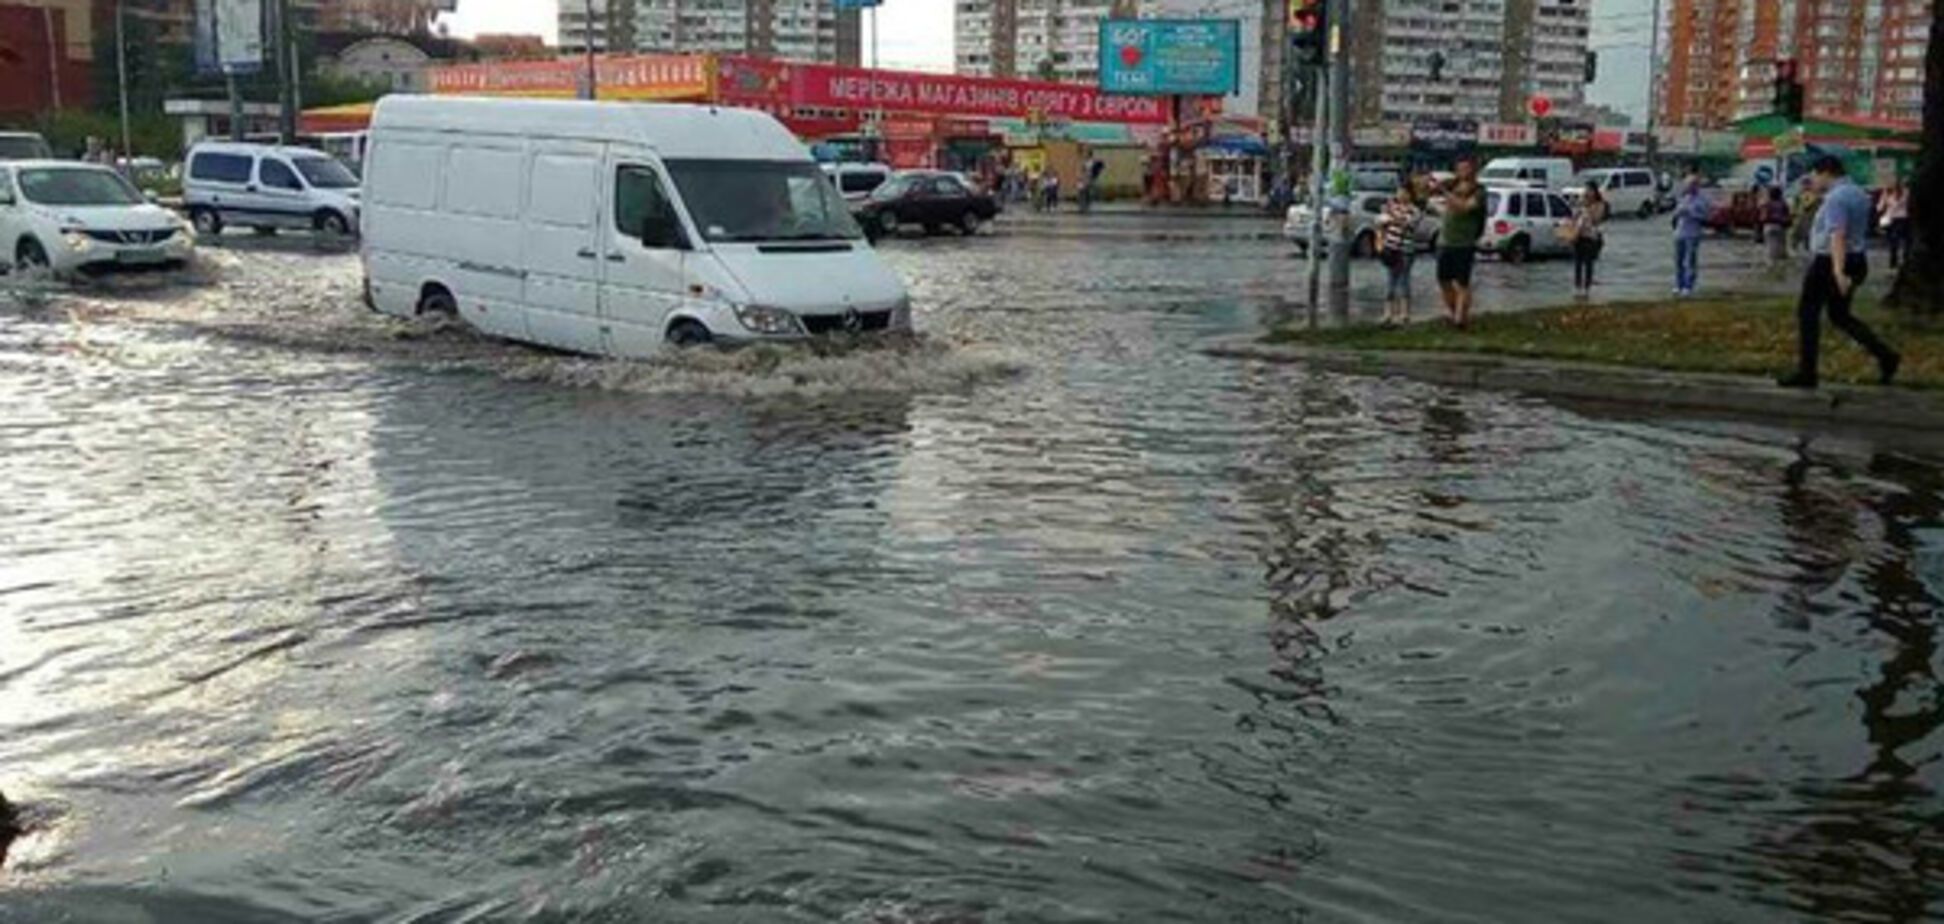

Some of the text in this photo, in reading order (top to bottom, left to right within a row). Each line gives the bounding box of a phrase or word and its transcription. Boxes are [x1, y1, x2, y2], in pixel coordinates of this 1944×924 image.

[829, 77, 913, 104] МЕРЕЖА
[917, 82, 1018, 110] МАГАЗИНІВ
[1024, 89, 1079, 114] ОДЯГУ
